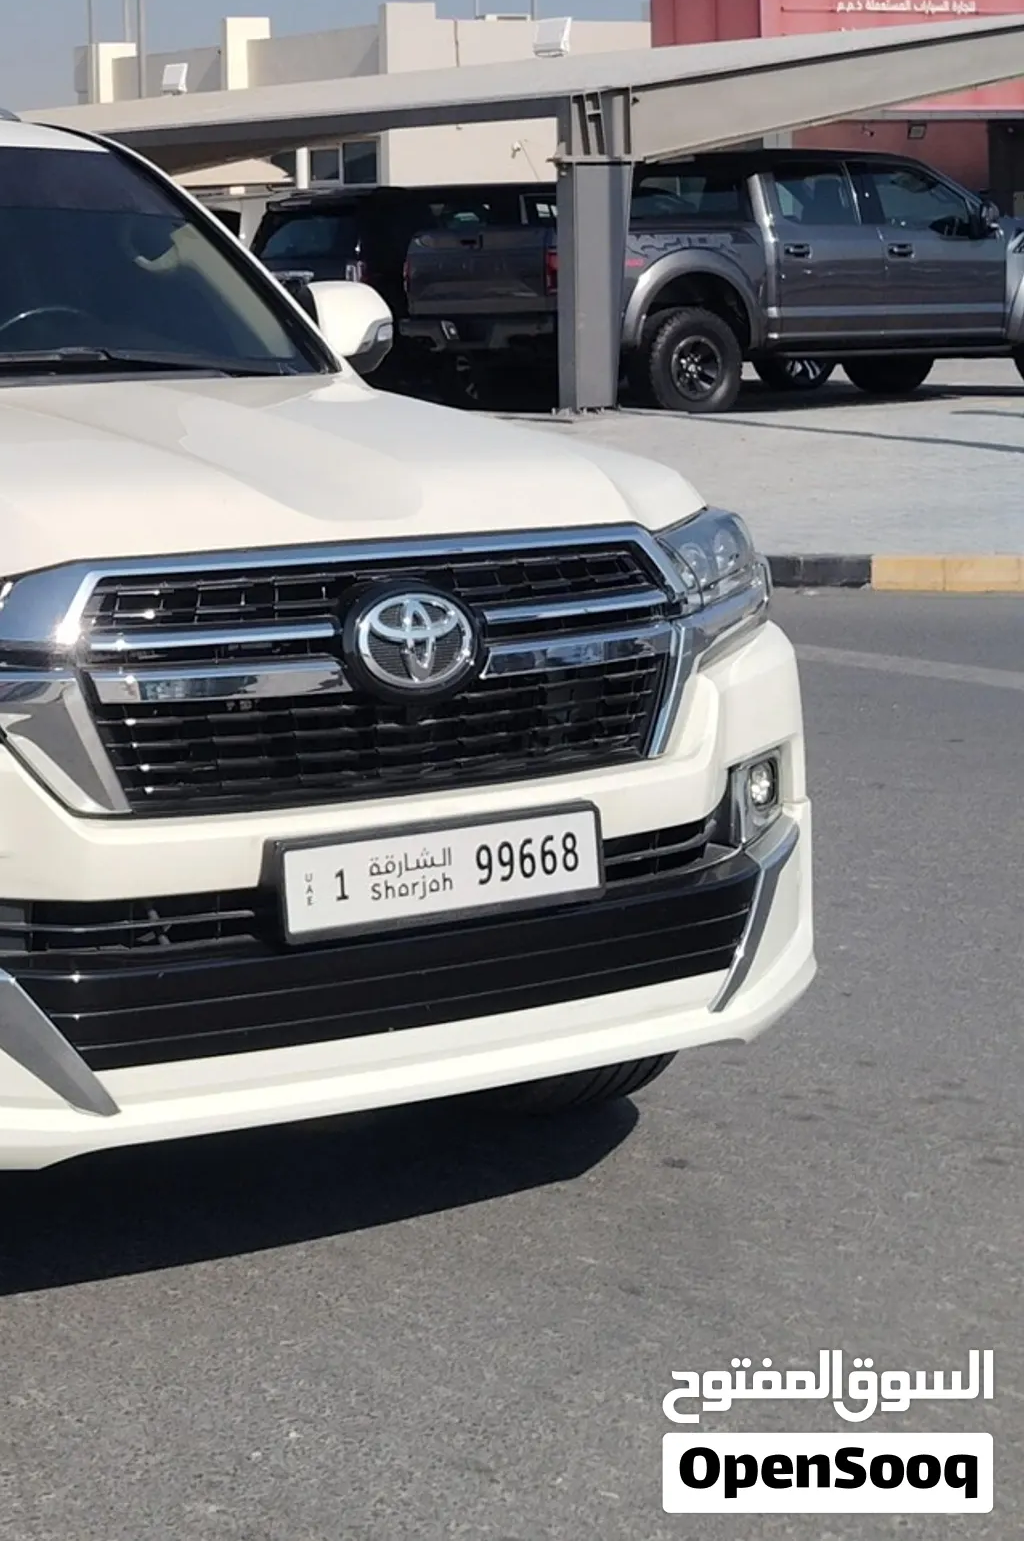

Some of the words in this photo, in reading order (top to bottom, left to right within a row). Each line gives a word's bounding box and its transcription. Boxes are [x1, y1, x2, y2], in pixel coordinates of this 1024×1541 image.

[369, 846, 452, 878] الشارقة
[476, 831, 579, 886] 99668
[334, 868, 350, 902] 1
[370, 872, 453, 901] Sharjah
